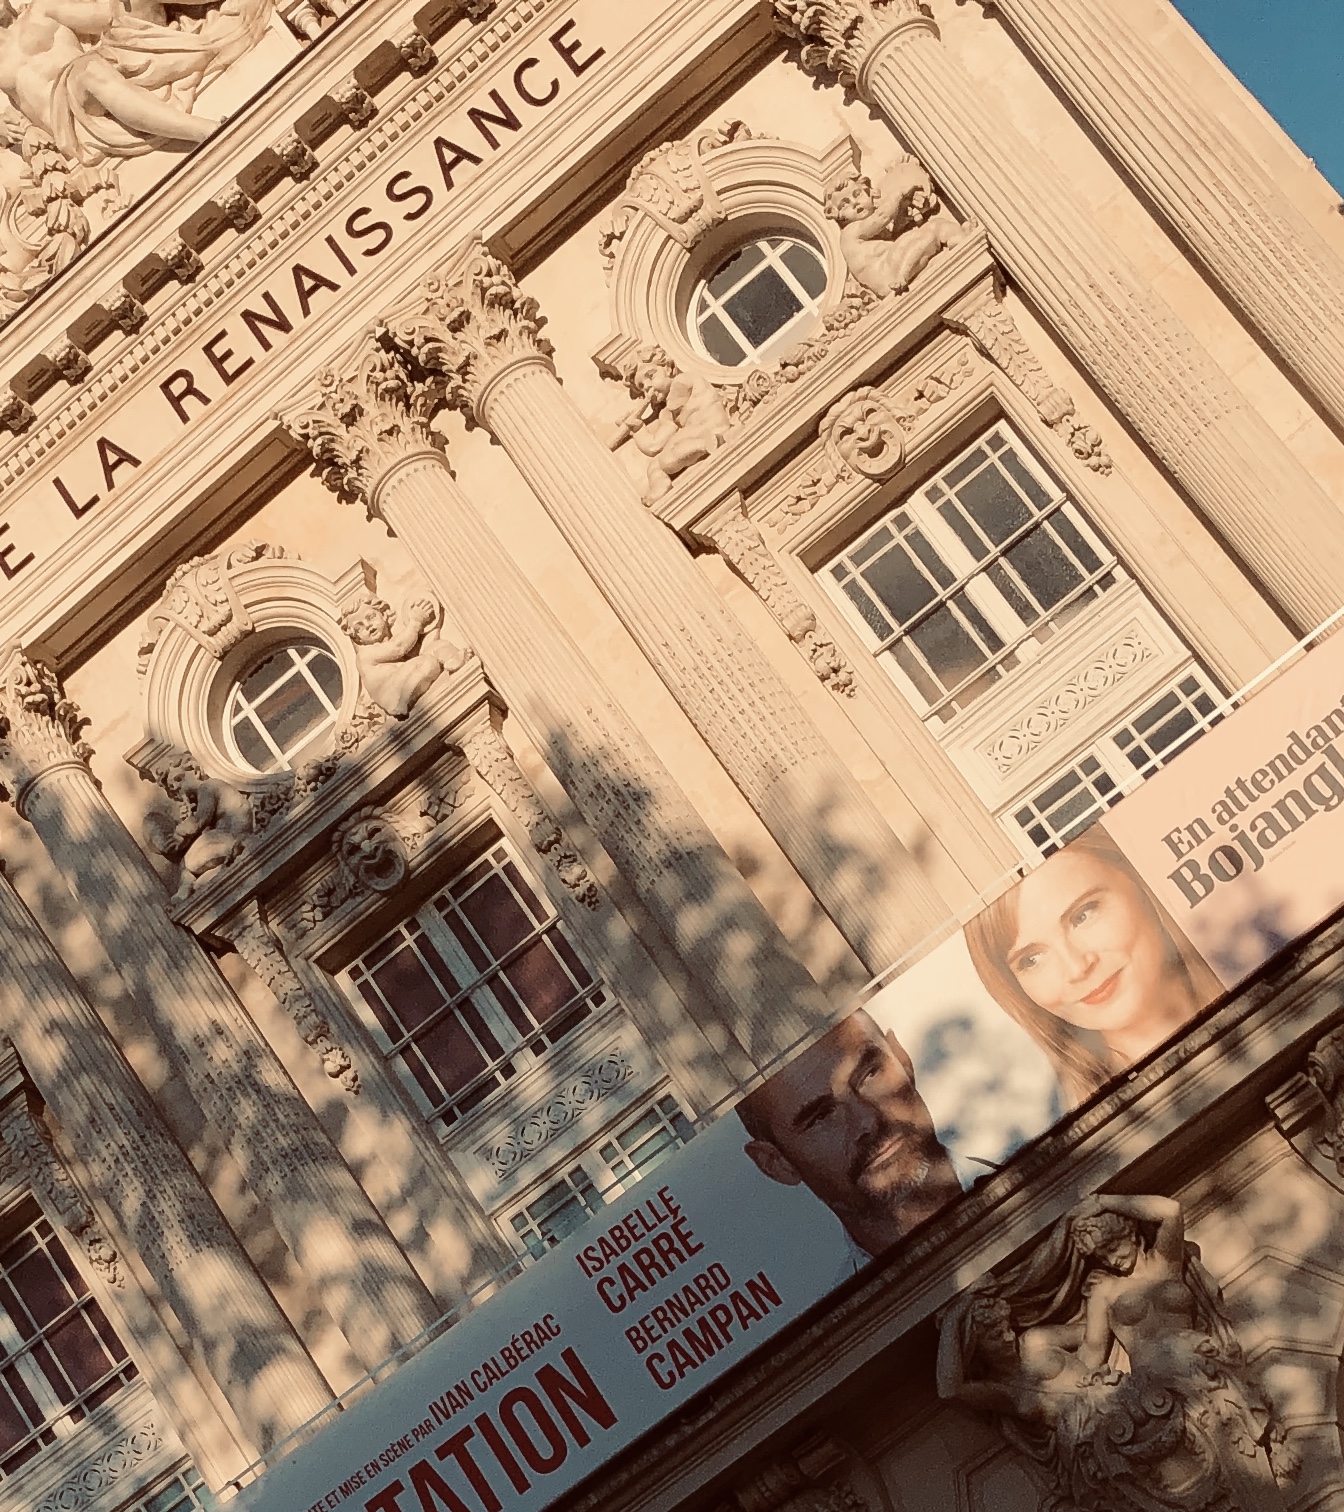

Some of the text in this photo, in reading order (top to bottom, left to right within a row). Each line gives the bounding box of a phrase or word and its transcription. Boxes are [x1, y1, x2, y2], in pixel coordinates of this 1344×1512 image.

[51, 436, 139, 520] LA
[160, 19, 605, 425] RENAISSANCE
[1161, 817, 1216, 863] En
[575, 1185, 683, 1278] ISABELLE
[596, 1208, 705, 1314] CARRÉ
[624, 1262, 732, 1355] BERNARD
[645, 1270, 783, 1391] CAMPAN
[323, 1489, 341, 1508] ET
[337, 1470, 367, 1498] MISE
[362, 1458, 382, 1478] EN
[377, 1433, 414, 1467] SCÈNE
[409, 1417, 435, 1442] PAR
[429, 1380, 472, 1427] IVAN
[469, 1313, 561, 1394] CALBÉRAC
